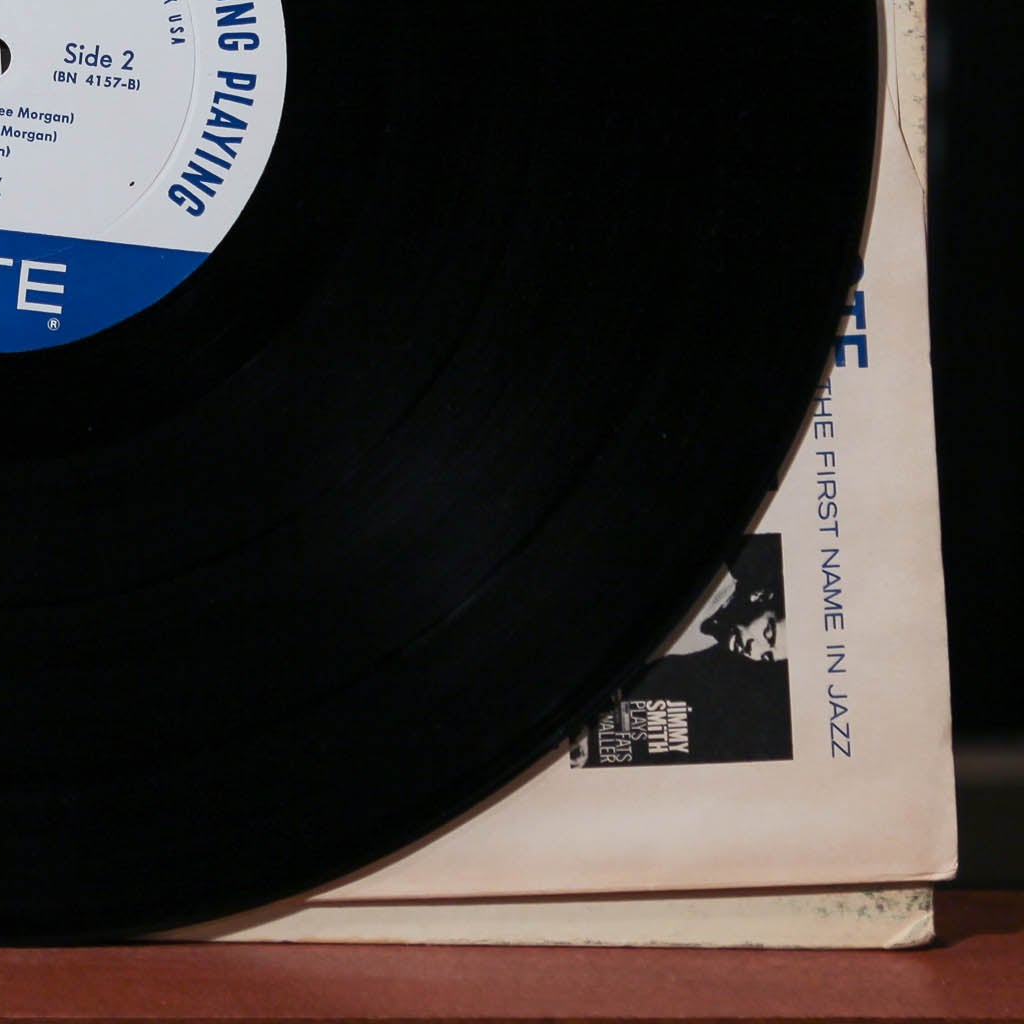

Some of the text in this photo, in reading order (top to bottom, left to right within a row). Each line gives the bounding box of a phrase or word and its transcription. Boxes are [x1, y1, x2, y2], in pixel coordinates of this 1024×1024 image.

[168, 14, 186, 45] USA
[63, 42, 135, 71] Side 2
[53, 70, 141, 91] (BN 4157-B)
[17, 106, 74, 125] Morgan)
[167, 70, 257, 217] PLAYING
[813, 377, 852, 759] THE FIRST NAME IN JAZZ
[630, 700, 647, 741] PLAYS
[615, 732, 633, 762] FATS
